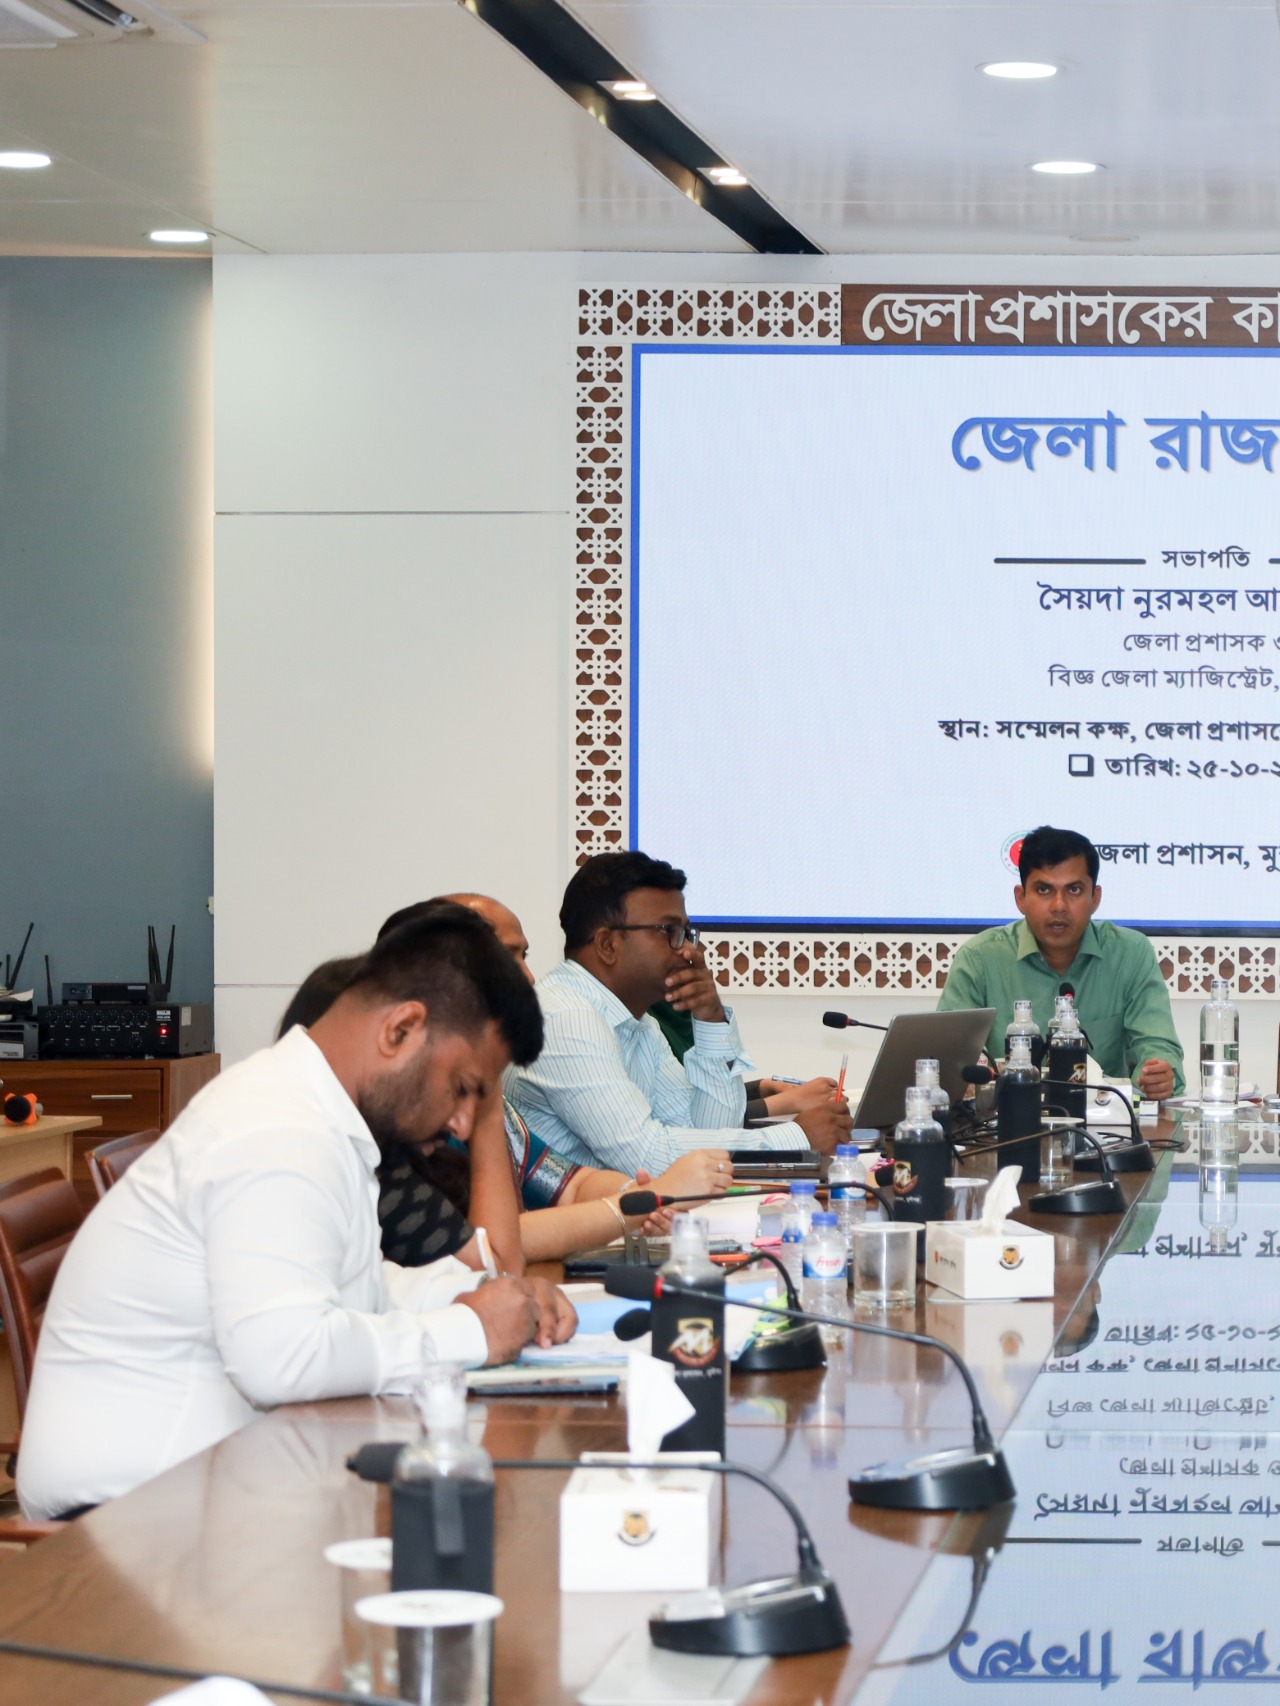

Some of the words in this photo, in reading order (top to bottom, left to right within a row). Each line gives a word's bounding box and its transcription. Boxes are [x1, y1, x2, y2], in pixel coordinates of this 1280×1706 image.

[862, 289, 984, 342] জেলা
[984, 289, 1214, 344] প্রশাসকের
[952, 410, 1126, 471] জেলা
[1162, 546, 1250, 568] সভাপতি
[1037, 581, 1125, 611] সৈয়দা
[1132, 589, 1238, 618] নুরমহল
[1124, 633, 1180, 651] জেলা
[1186, 633, 1266, 652] প্রশাসক
[1048, 664, 1095, 686] বিজ্ঞ
[1102, 669, 1158, 687] জেলা
[938, 719, 988, 740] স্থান:
[996, 721, 1081, 739] সম্মেলন
[1086, 722, 1136, 743] কক্ষ,
[1145, 721, 1202, 740] জেলা
[1105, 753, 1180, 776] তারিখ:
[1157, 843, 1249, 869] প্রশাসন,
